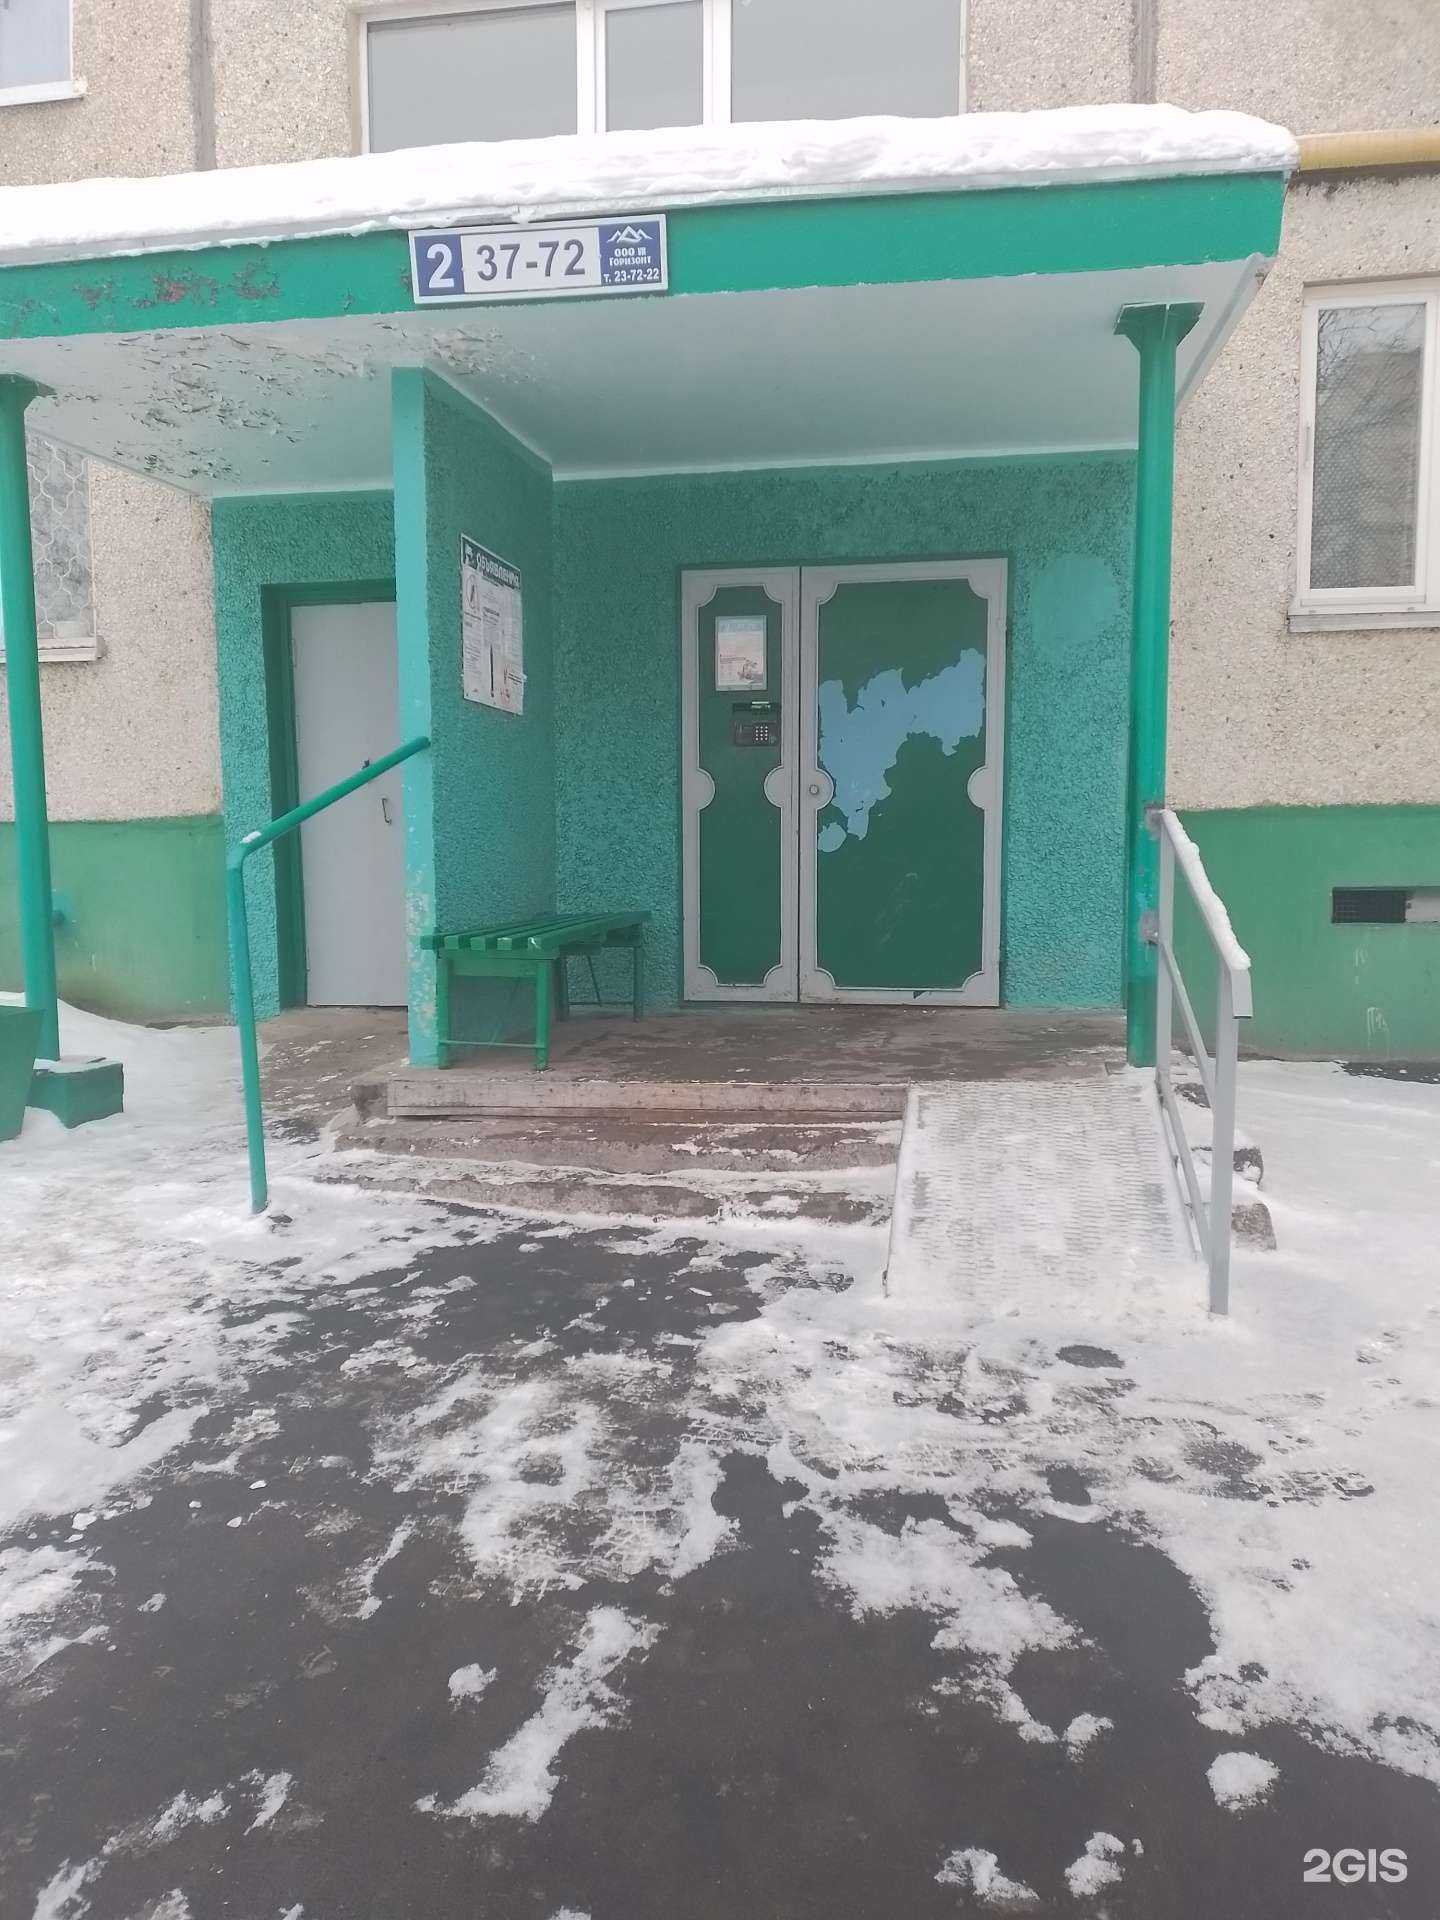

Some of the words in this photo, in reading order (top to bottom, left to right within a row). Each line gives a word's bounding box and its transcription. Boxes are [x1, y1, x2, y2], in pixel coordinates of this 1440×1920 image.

[614, 247, 636, 257] ООО
[426, 243, 455, 288] 2
[476, 239, 586, 282] 37-72
[609, 256, 651, 266] ГОРИЗОНТ
[614, 267, 660, 282] 23-72-22
